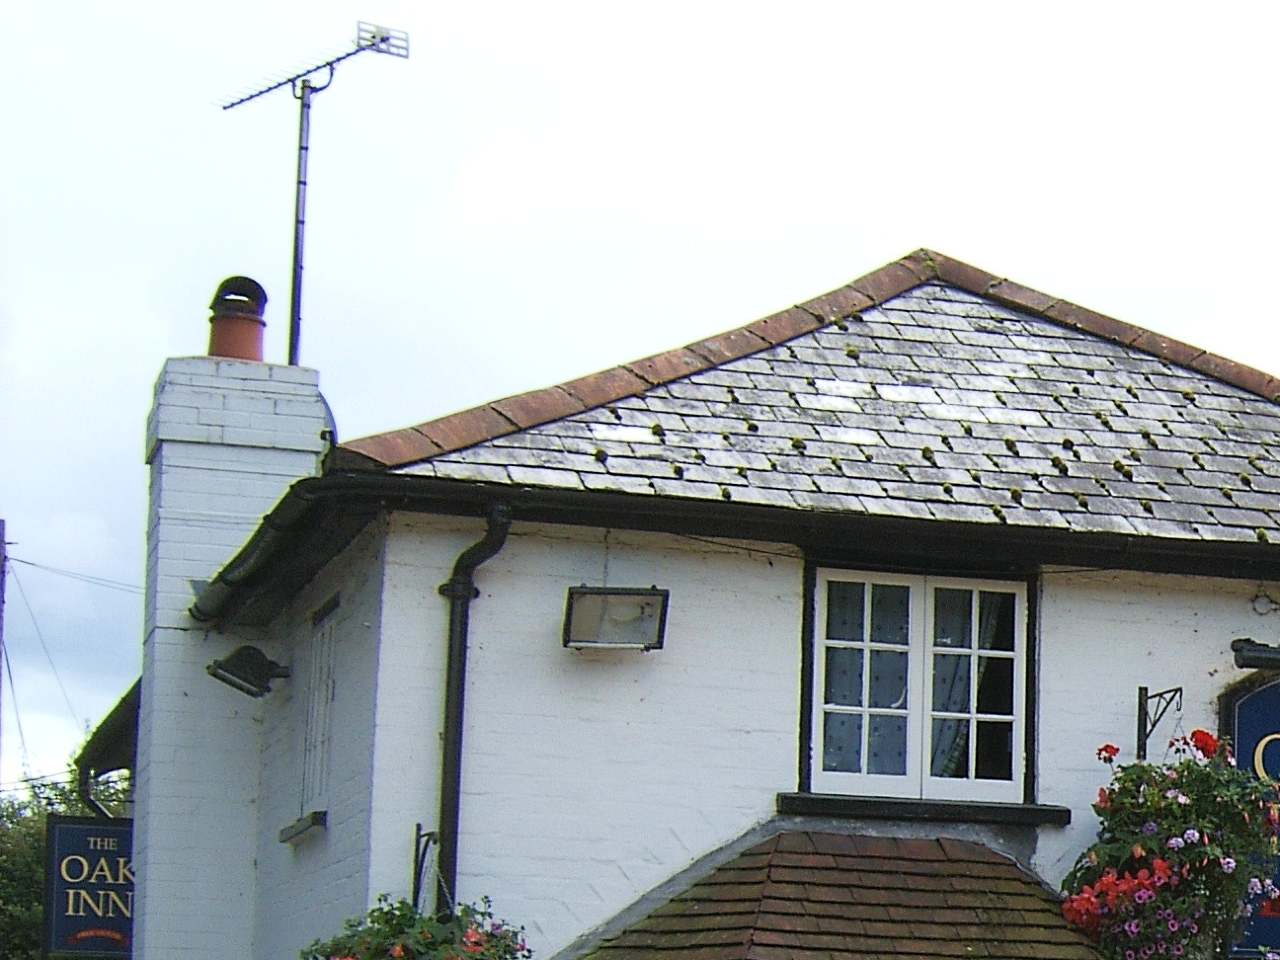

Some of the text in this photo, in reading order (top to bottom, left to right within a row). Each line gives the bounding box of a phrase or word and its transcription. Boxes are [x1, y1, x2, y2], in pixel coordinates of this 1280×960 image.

[87, 837, 118, 850] THE
[60, 855, 134, 884] OAK
[65, 889, 133, 918] INN
